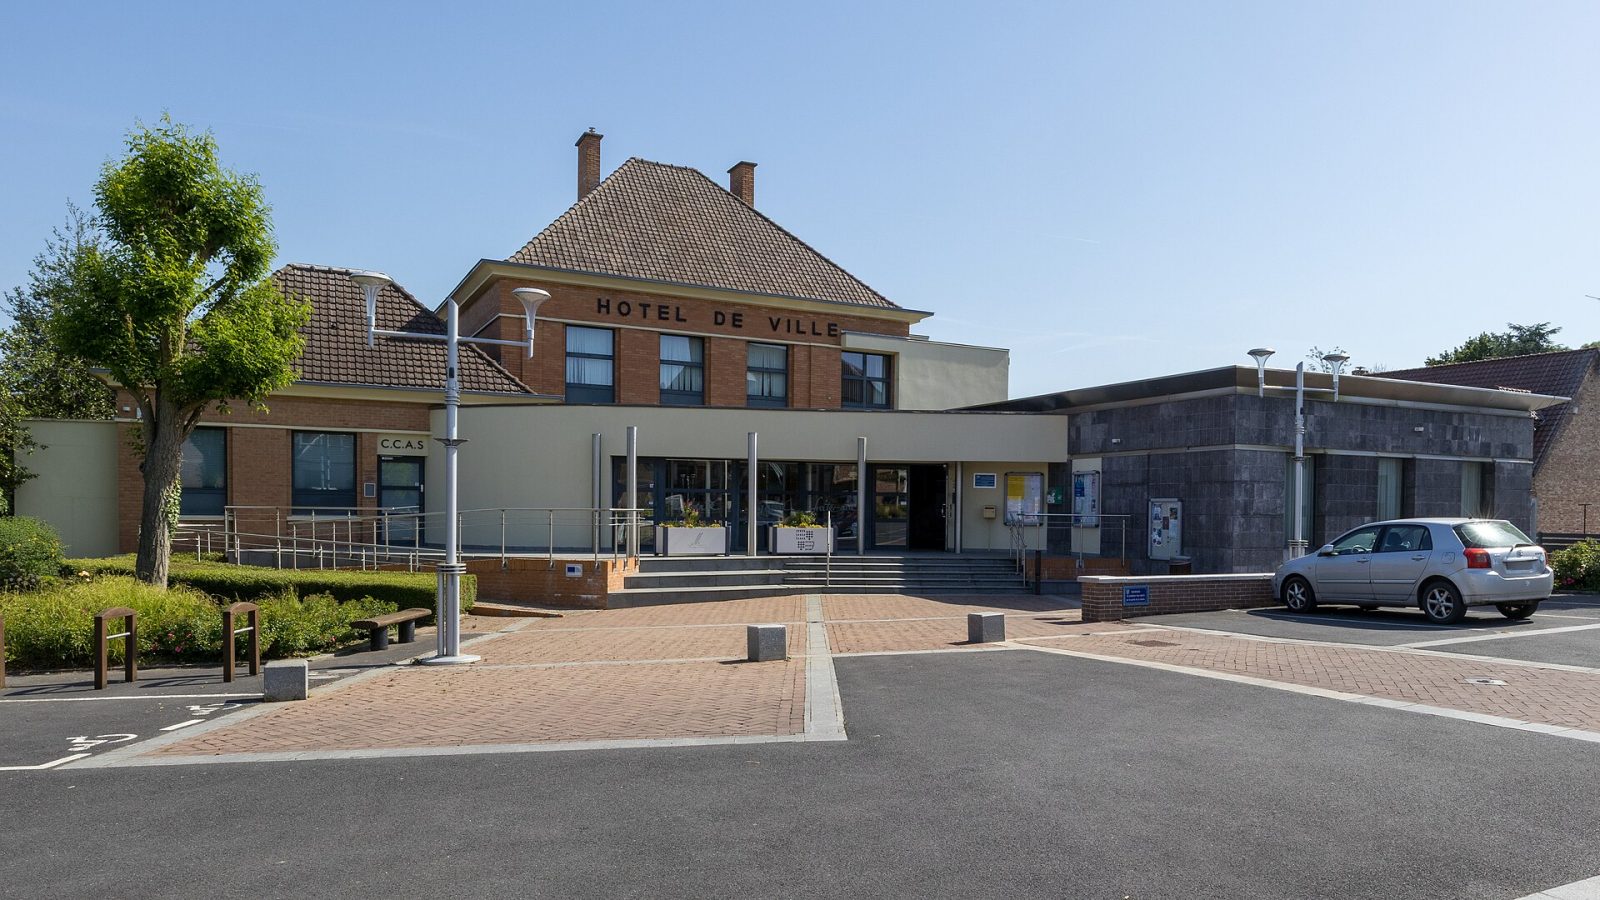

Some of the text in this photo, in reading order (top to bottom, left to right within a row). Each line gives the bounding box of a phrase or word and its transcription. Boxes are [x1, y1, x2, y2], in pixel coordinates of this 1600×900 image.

[597, 298, 838, 337] HOTEL DE VILLE
[381, 438, 424, 450] C.C.A.S
